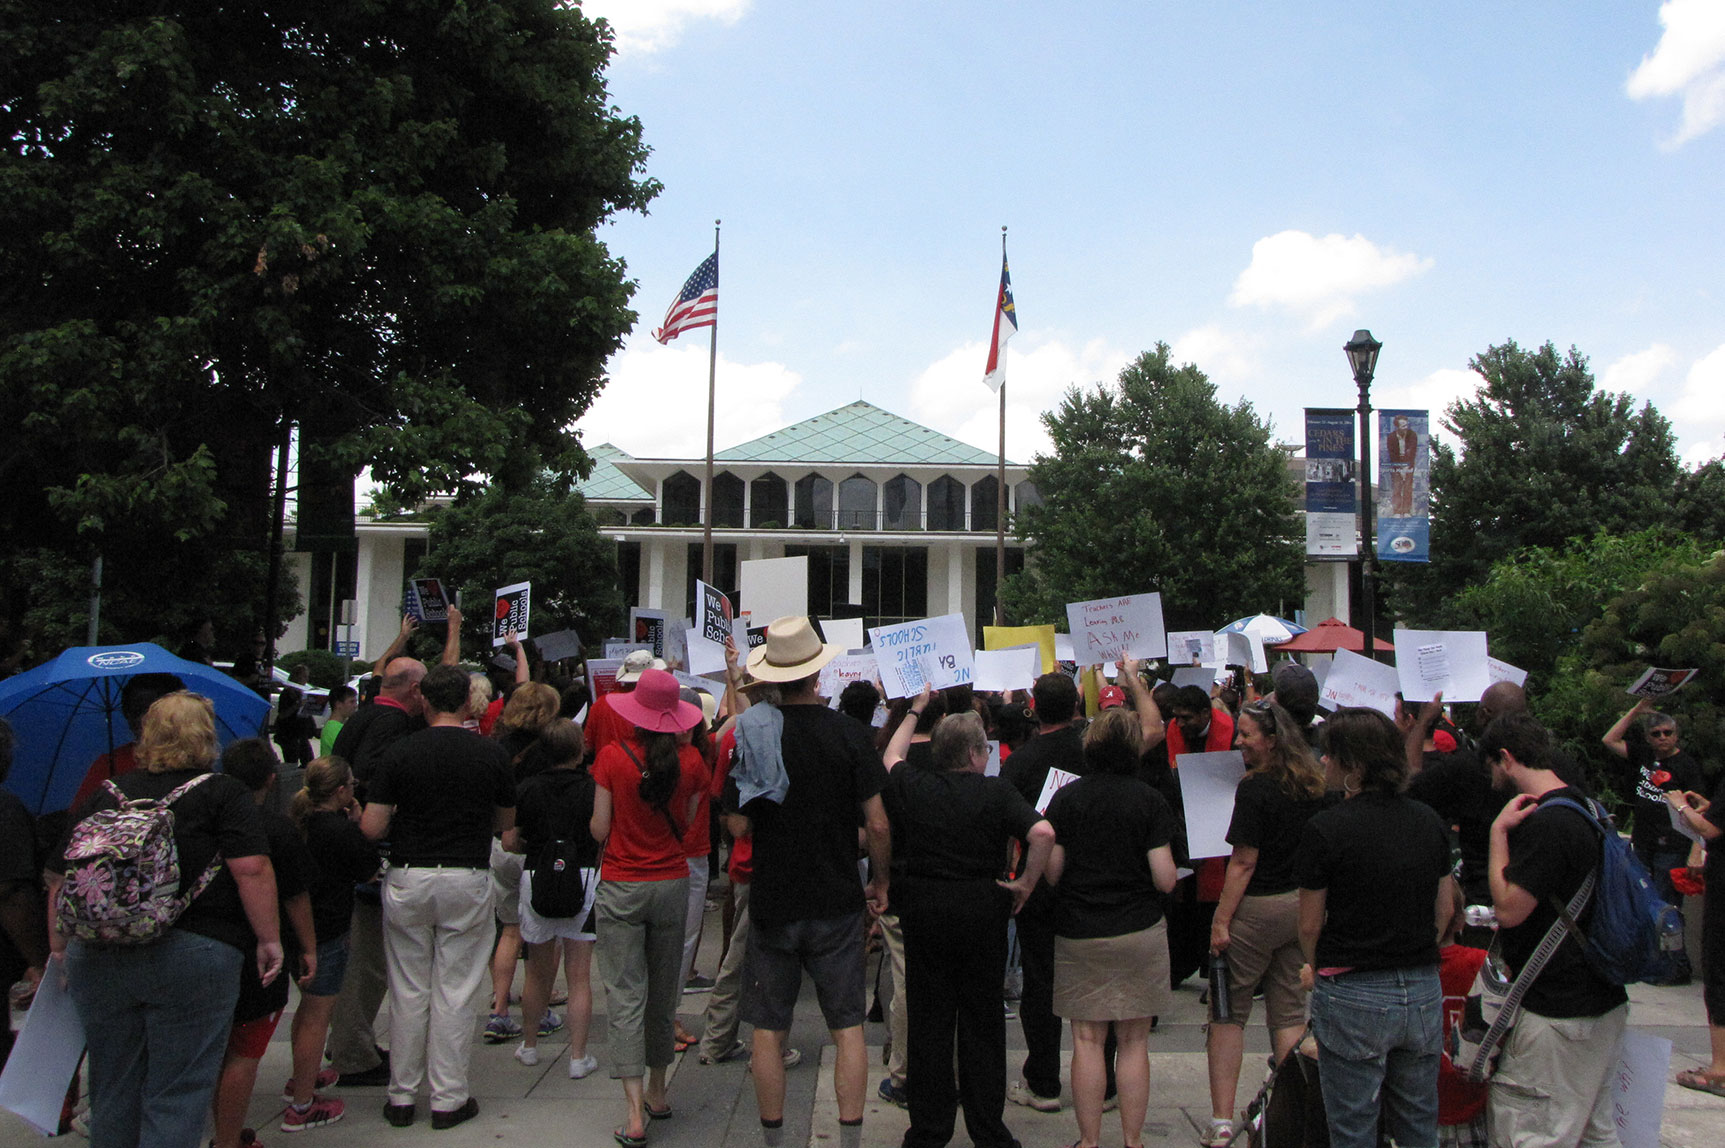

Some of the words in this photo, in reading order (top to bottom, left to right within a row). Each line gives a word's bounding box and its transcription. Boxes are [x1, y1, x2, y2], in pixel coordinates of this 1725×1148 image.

[518, 590, 528, 630] Schools
[706, 593, 722, 611] We
[499, 618, 508, 637] We
[880, 625, 928, 648] SCHOOLS
[748, 634, 764, 645] We
[954, 667, 971, 683] NC
